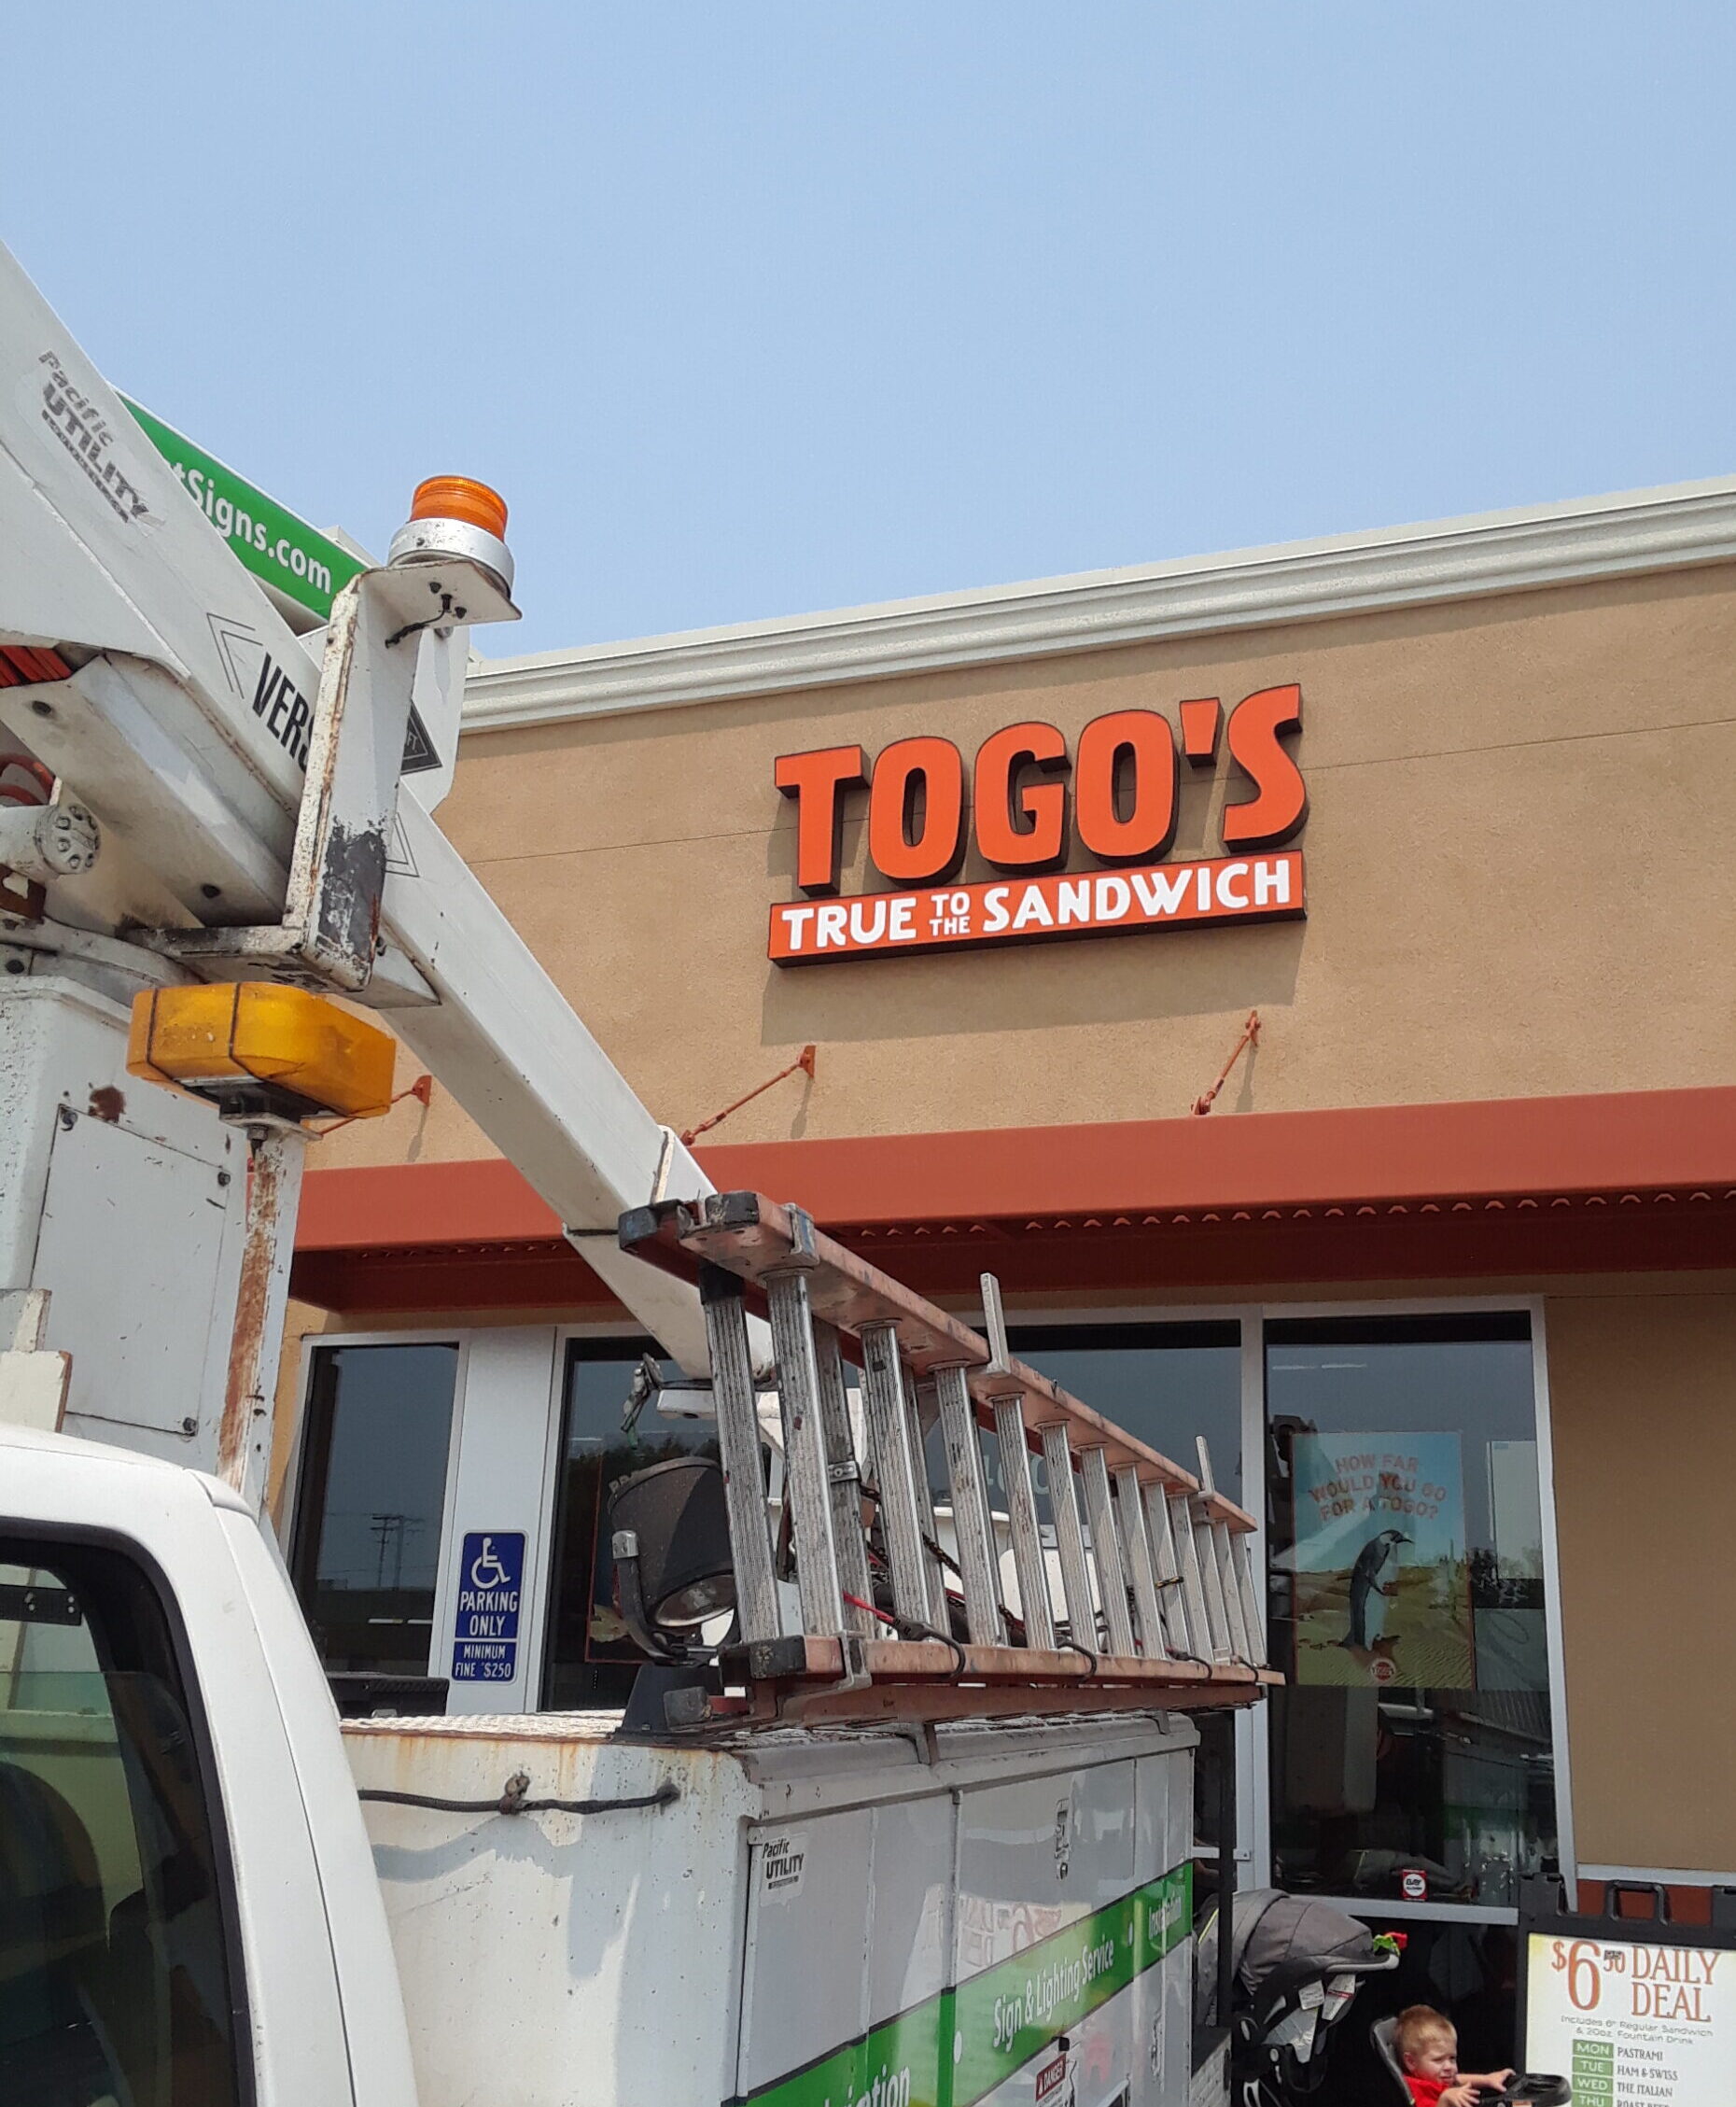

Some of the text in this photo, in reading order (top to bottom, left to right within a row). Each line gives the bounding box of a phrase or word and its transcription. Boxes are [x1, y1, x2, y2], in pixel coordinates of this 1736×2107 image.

[38, 351, 113, 447] Pacific
[43, 383, 149, 520] UTILITY
[775, 683, 1308, 892] TOGO'S
[781, 860, 1291, 950] TRUE TO THE SANDWICH
[1335, 1454, 1419, 1473] HOW FAR
[1309, 1471, 1448, 1502] WOULD YOU GO
[1319, 1498, 1354, 1521] FOR
[459, 1590, 519, 1613] PARKING
[469, 1614, 506, 1636] ONLY
[463, 1643, 506, 1660] MINIMUM
[455, 1662, 477, 1678] FINE
[762, 1837, 791, 1860] Pacific
[765, 1852, 805, 1880] UTILITY
[1631, 1945, 1721, 1985] DAILY
[993, 1933, 1114, 2053] Sign & Lighting Service
[1631, 1981, 1712, 2022] DEAL
[1561, 2015, 1603, 2027] Includes
[1619, 2020, 1659, 2032] Regular
[1661, 2024, 1714, 2037] Sandwich
[1617, 2030, 1664, 2042] Fountain
[1666, 2035, 1693, 2044] Drink
[1576, 2043, 1663, 2061] MON PASTRAMI
[1580, 2060, 1679, 2082] TUE HAM & SWISS
[1577, 2077, 1673, 2097] WED THE ITALIAN
[1579, 2095, 1604, 2107] THU
